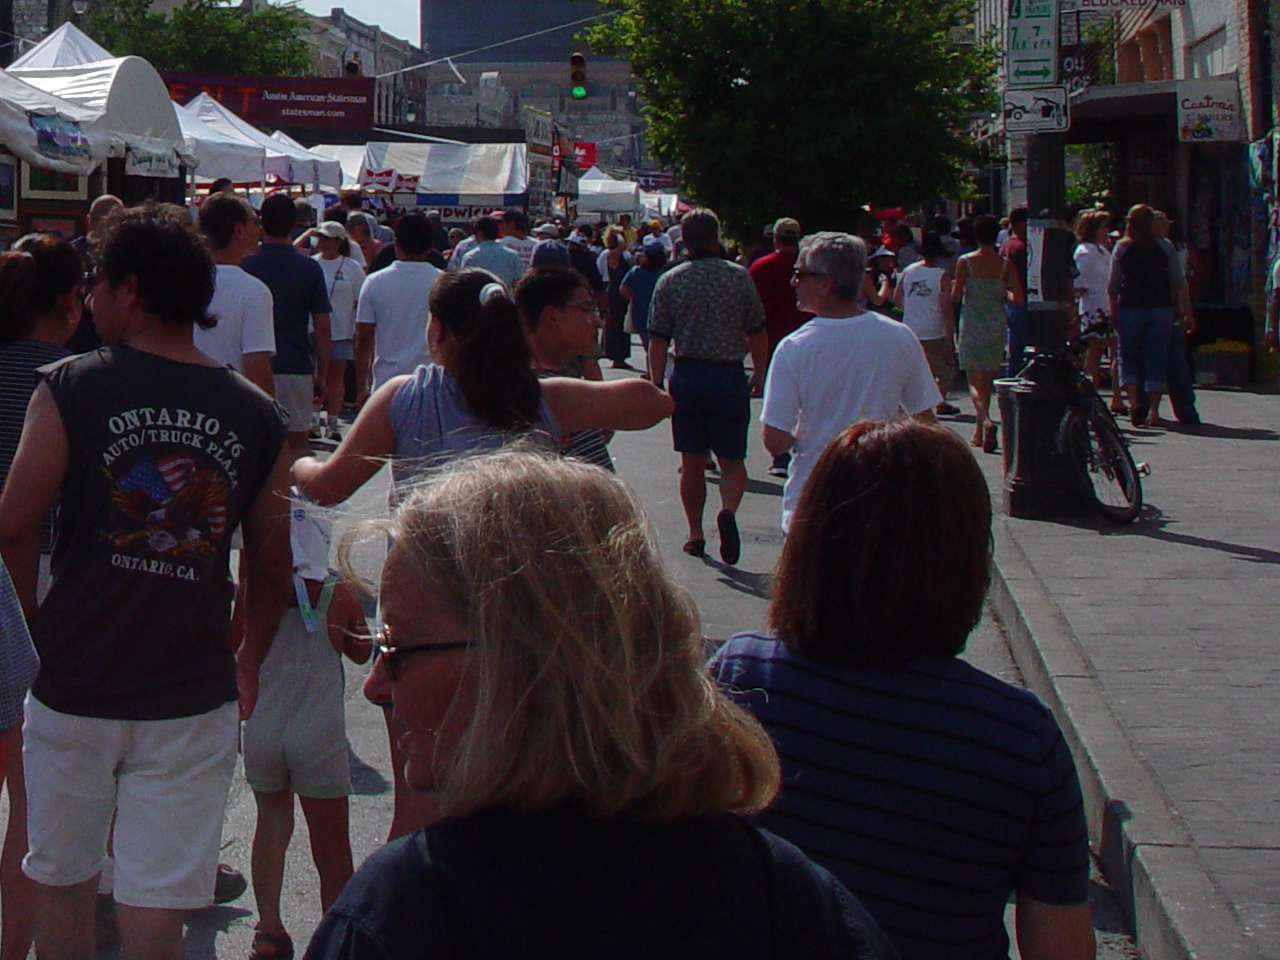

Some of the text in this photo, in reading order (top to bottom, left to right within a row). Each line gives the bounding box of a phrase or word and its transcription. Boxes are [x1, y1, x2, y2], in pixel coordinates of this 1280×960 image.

[262, 90, 287, 101] Austin
[281, 107, 346, 118] statesman.com
[108, 407, 244, 459] ONTARIO 76
[102, 428, 205, 467] AUTO/TRUCK
[176, 565, 200, 581] CA.
